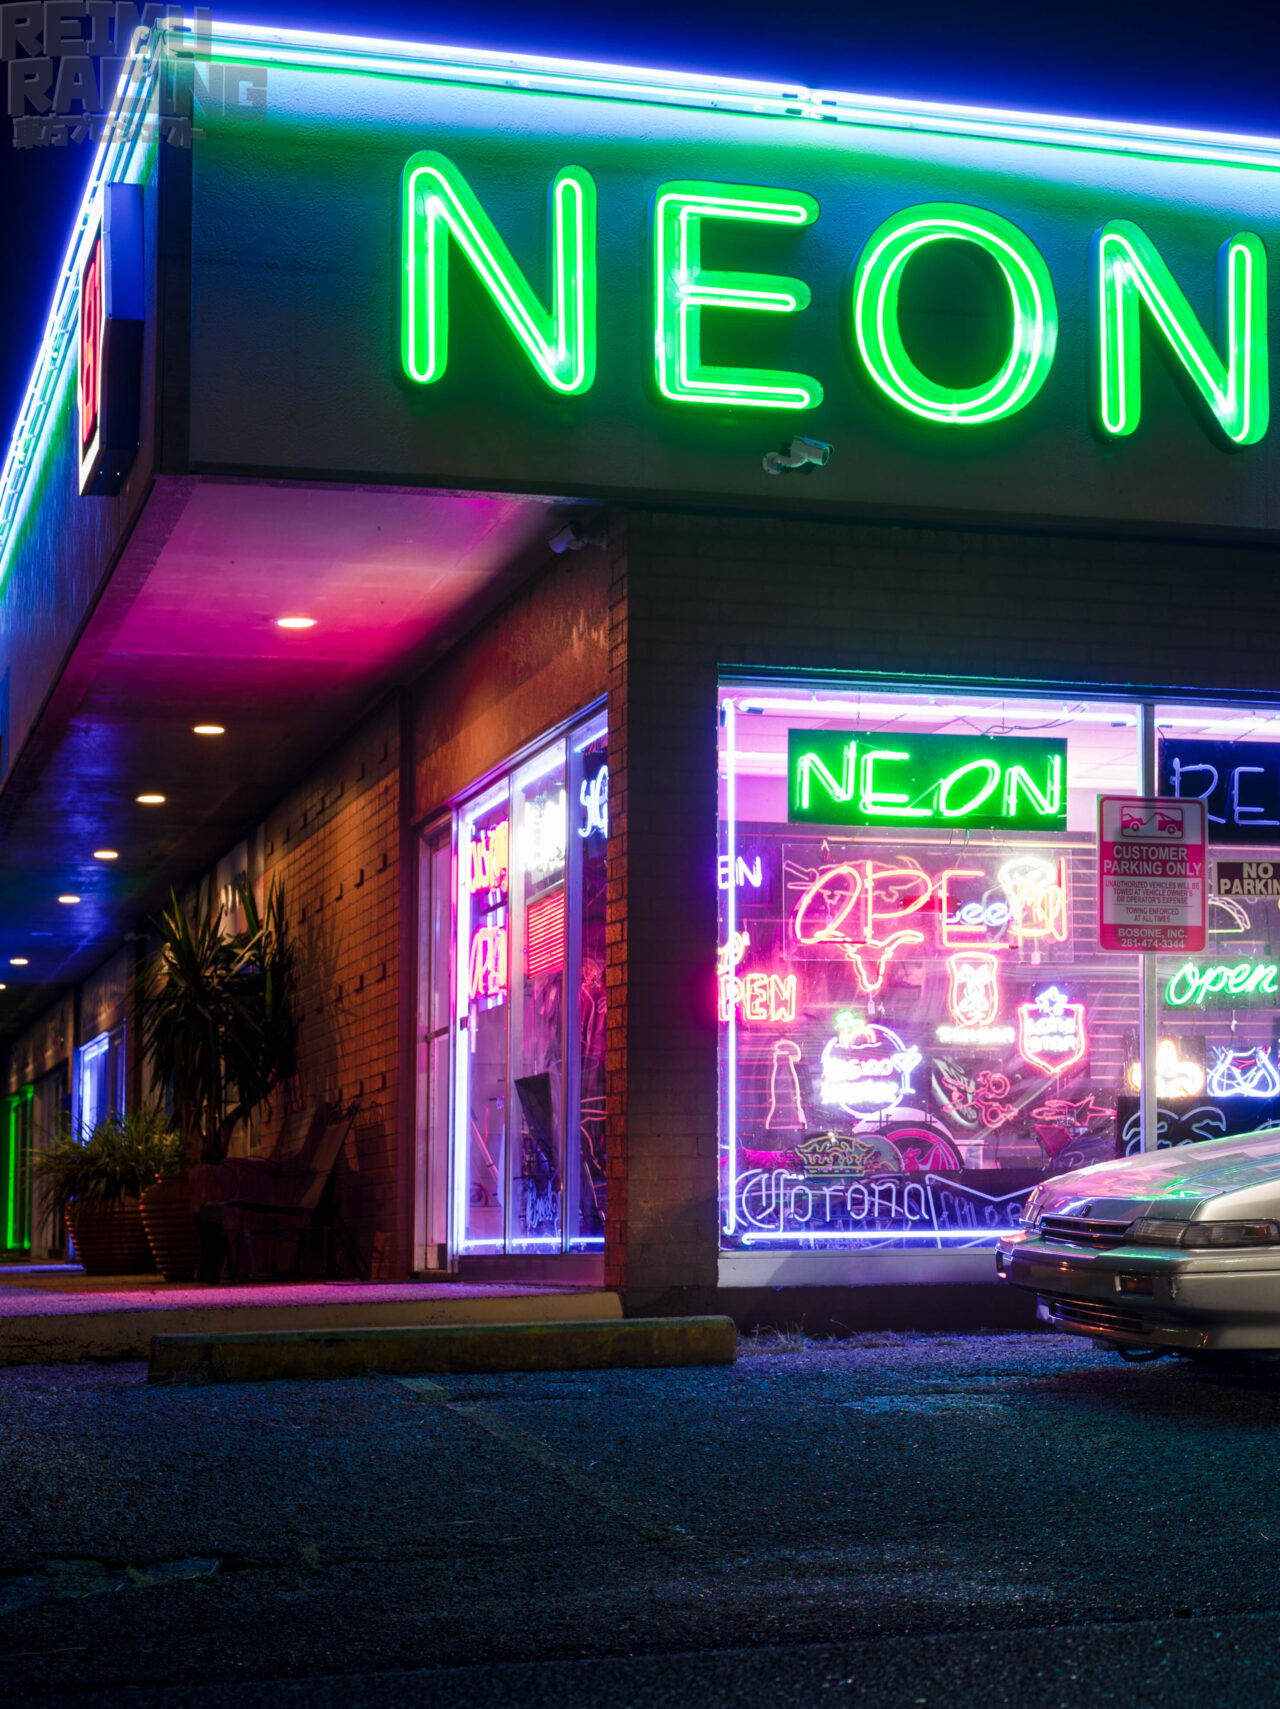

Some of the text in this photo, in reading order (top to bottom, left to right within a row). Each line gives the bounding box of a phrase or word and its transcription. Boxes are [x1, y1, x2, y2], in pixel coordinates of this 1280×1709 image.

[400, 150, 1271, 446] NEON
[796, 740, 1062, 818] NEON
[1113, 845, 1188, 861] CUSTOMER
[1103, 860, 1202, 876] PARKING ONLY
[1242, 862, 1274, 880] NO
[1113, 888, 1134, 896] TOWED
[1142, 889, 1166, 897] VEHICLE
[1149, 881, 1177, 889] VEHICLES
[1177, 882, 1191, 890] WILL
[794, 856, 1068, 950] OPEN
[1116, 895, 1126, 903] OR
[1162, 897, 1188, 905] EXPENSE
[1126, 906, 1180, 916] TOWING ENFORCED
[1134, 914, 1143, 922] AT
[1154, 915, 1171, 923] TIMES
[1118, 927, 1188, 939] BOSONE, INC.
[1121, 938, 1185, 949] 281-474-3344
[734, 1168, 930, 1232] Corona
